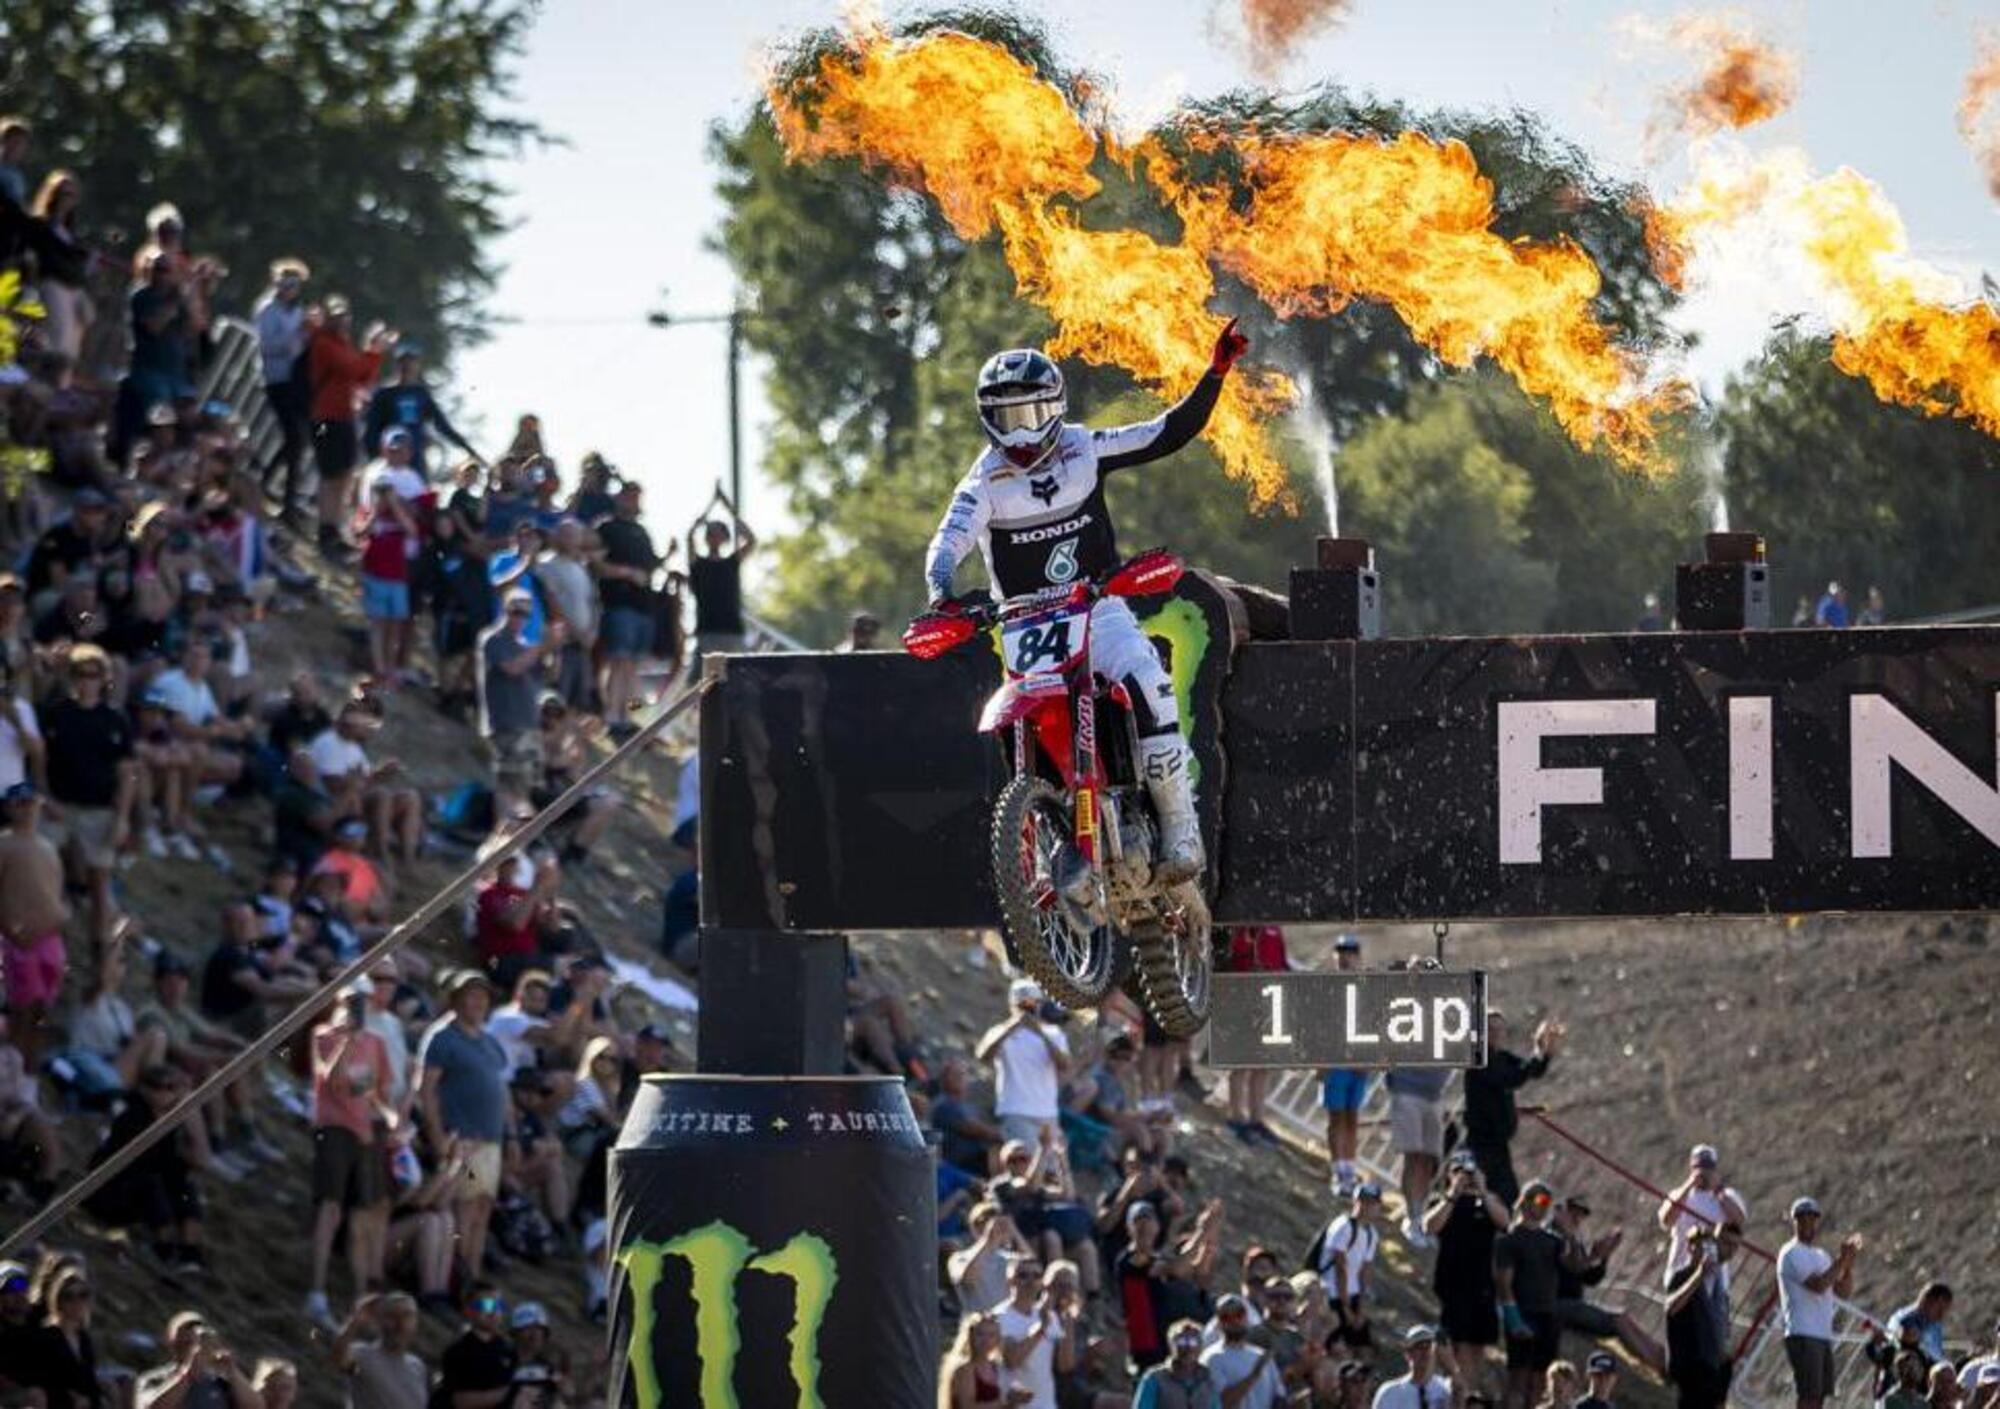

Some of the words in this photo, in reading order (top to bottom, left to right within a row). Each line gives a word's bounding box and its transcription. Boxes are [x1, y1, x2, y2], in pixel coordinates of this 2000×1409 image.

[1010, 514, 1092, 544] HONDA
[1016, 622, 1071, 671] 84
[1261, 984, 1293, 1045] 1
